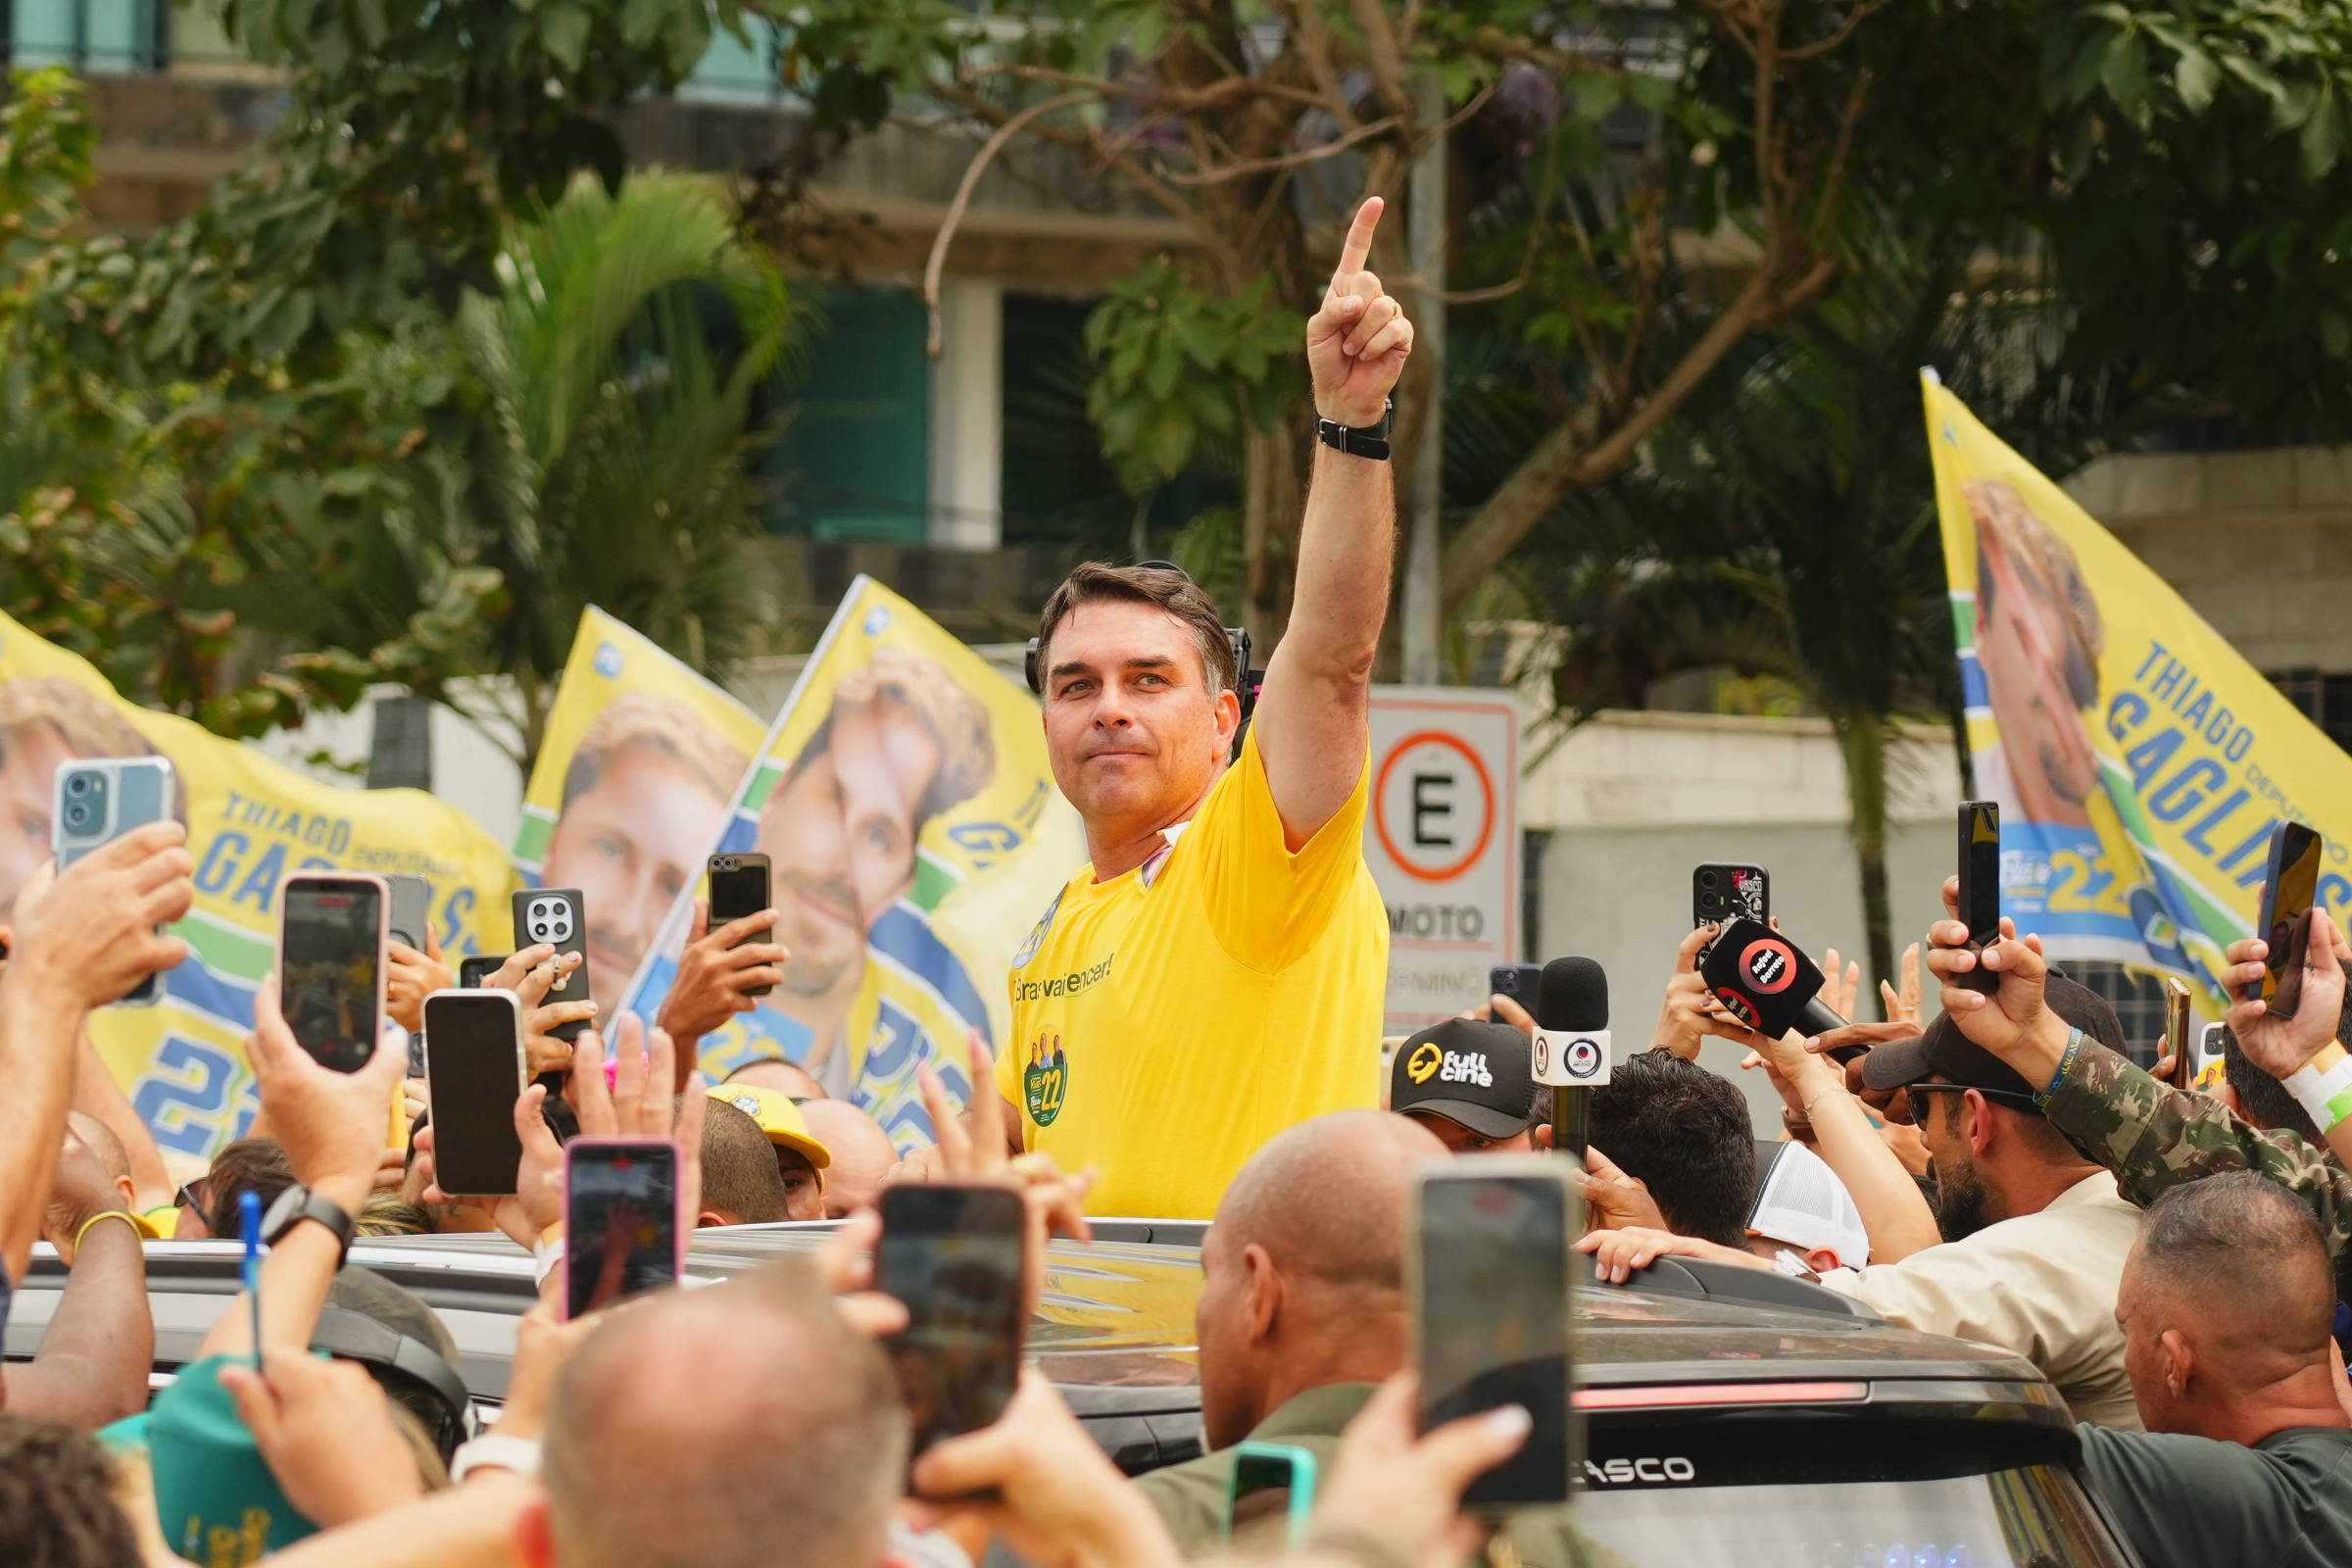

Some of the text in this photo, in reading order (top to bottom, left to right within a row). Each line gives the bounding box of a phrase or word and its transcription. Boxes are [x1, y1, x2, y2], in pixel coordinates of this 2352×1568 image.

[2134, 640, 2255, 762] THIAGO
[222, 790, 353, 855] THIAGO
[1412, 772, 1454, 848] E
[1739, 880, 1762, 893] VASCO
[2047, 850, 2131, 917] 22
[1440, 1067, 1494, 1088] cine
[1443, 1050, 1489, 1074] full
[1041, 1068, 1062, 1111] 22
